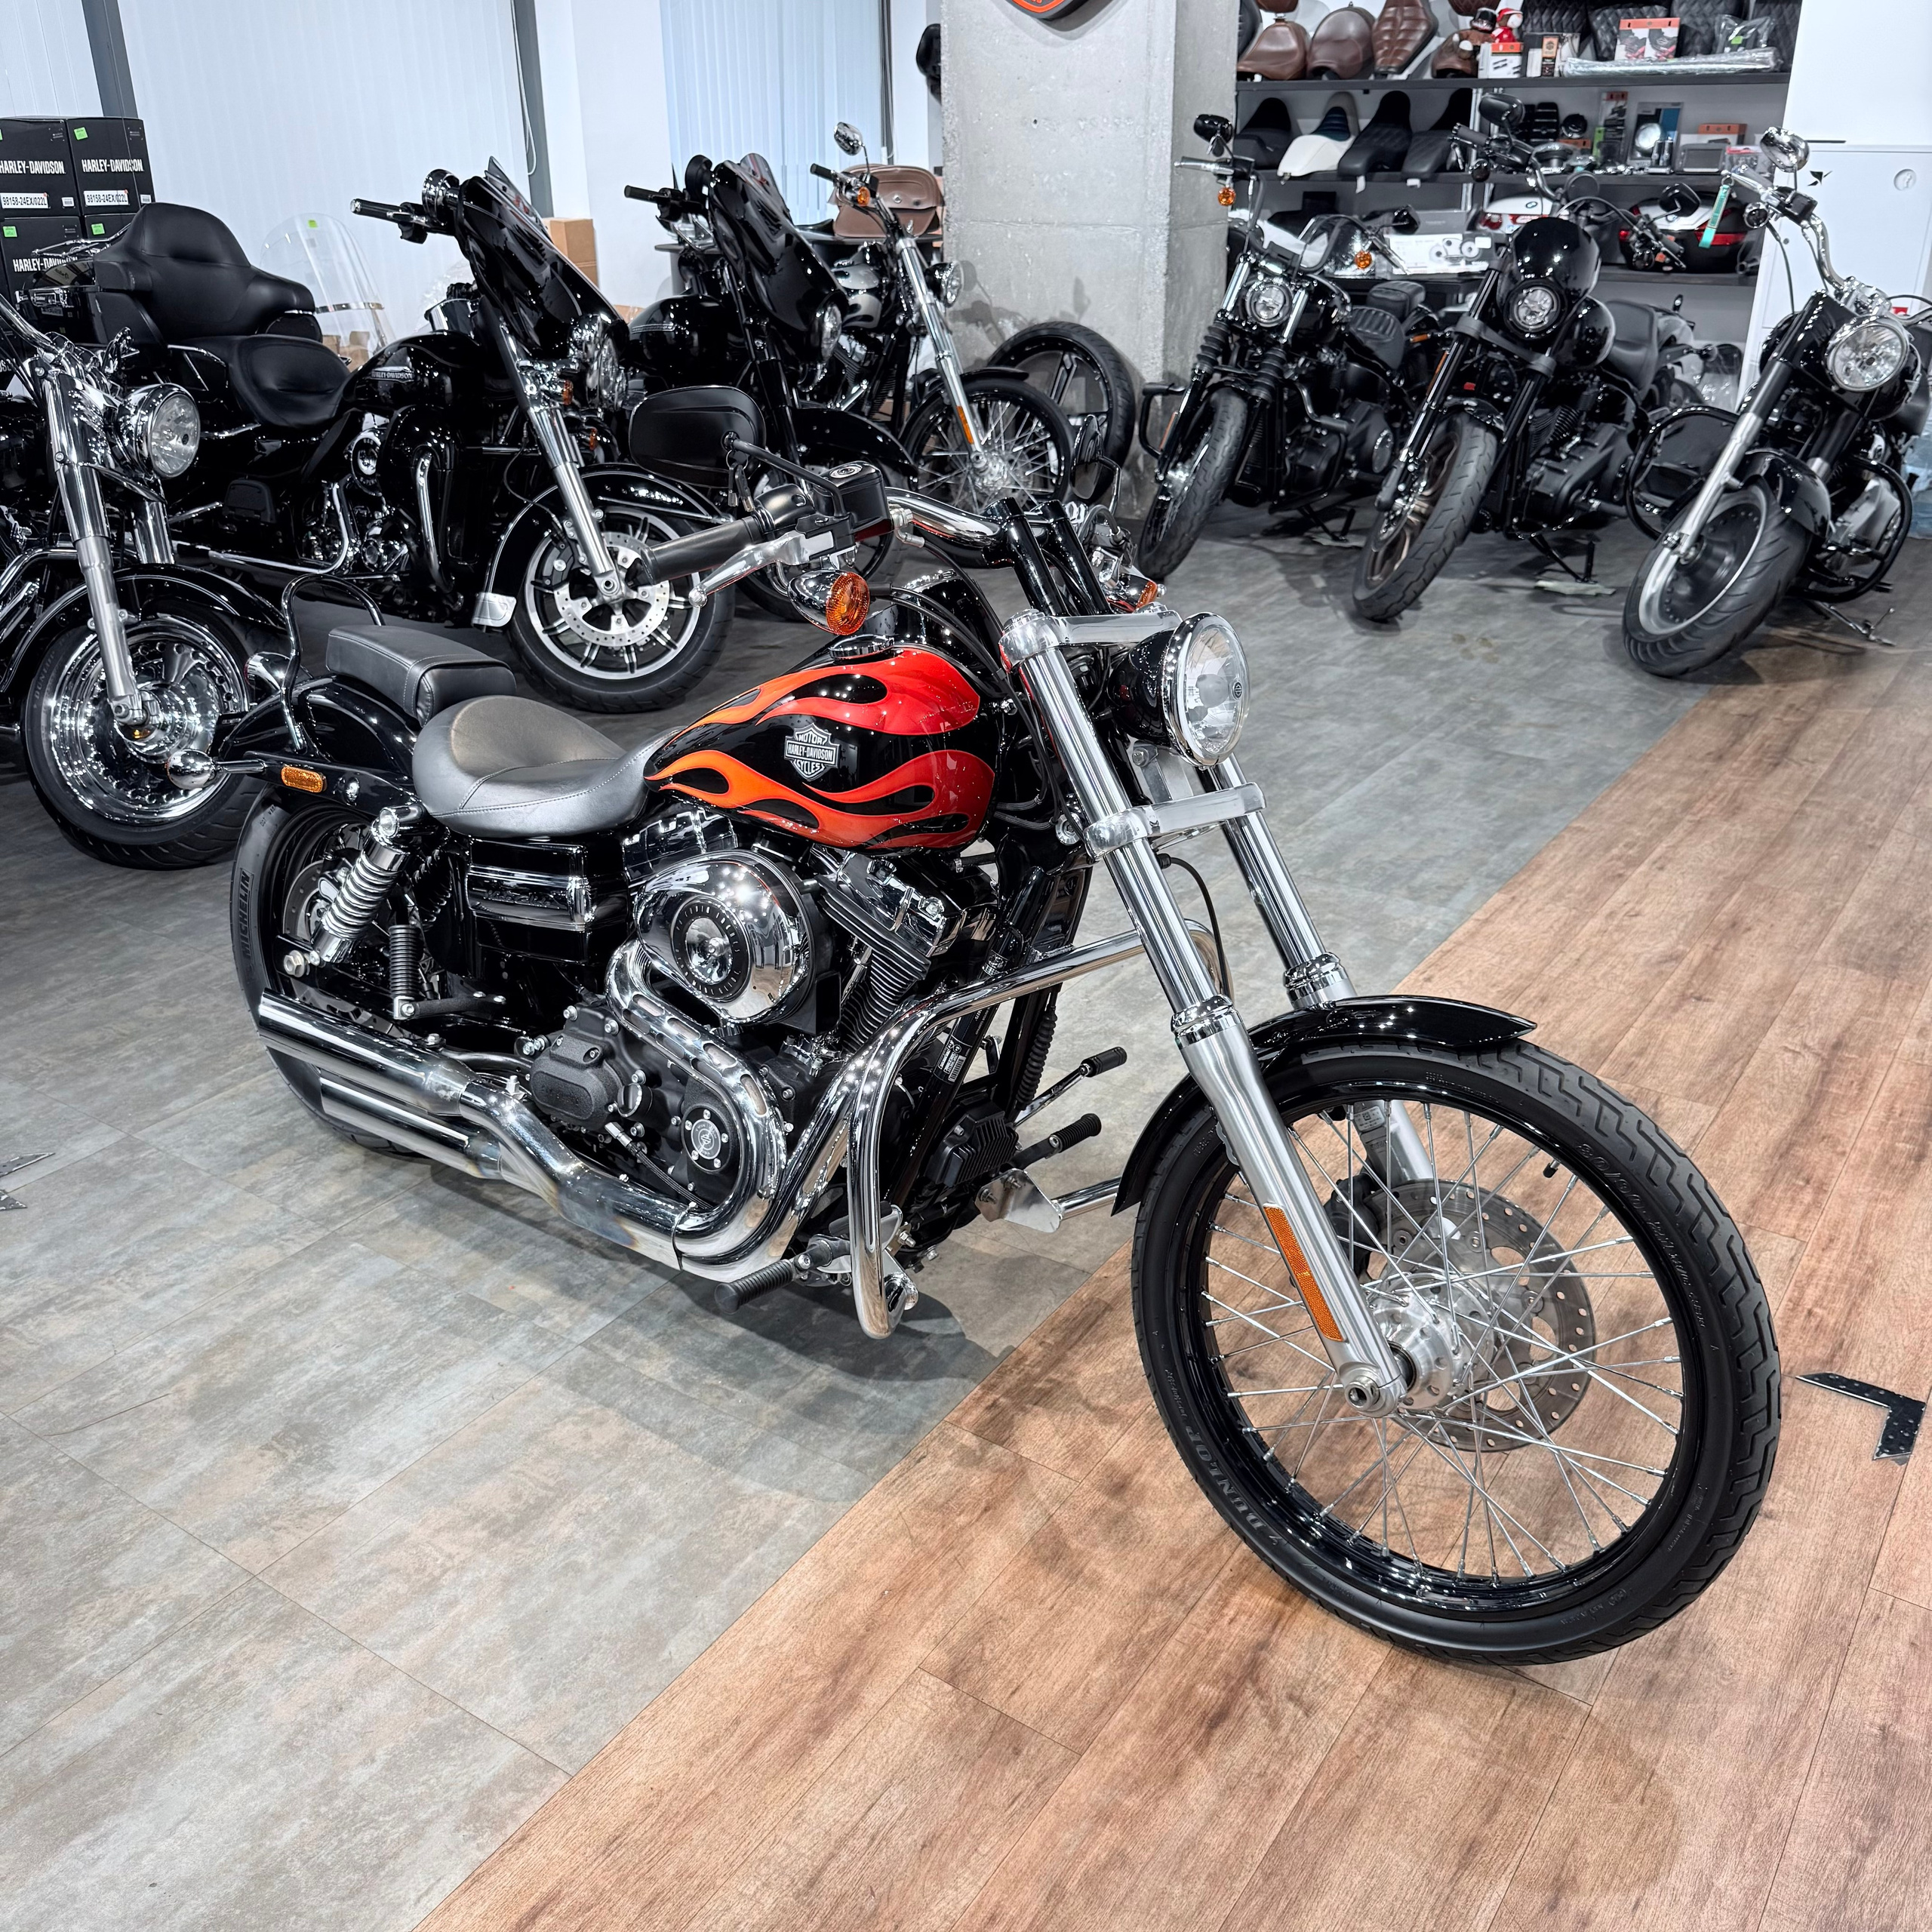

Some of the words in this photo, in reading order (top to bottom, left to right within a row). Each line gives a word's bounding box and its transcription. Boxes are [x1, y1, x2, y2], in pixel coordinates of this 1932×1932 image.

[0, 160, 65, 174] HARLEY-DAVIDSON
[82, 158, 143, 173] HARLEY-DAVIDSON
[798, 731, 823, 746] MOTOR
[788, 743, 833, 761] HARLEY-DAVIDSON
[796, 759, 820, 775] CYCLES
[238, 870, 251, 960] MICHELIN
[1185, 1426, 1266, 1531] DUNLOP
